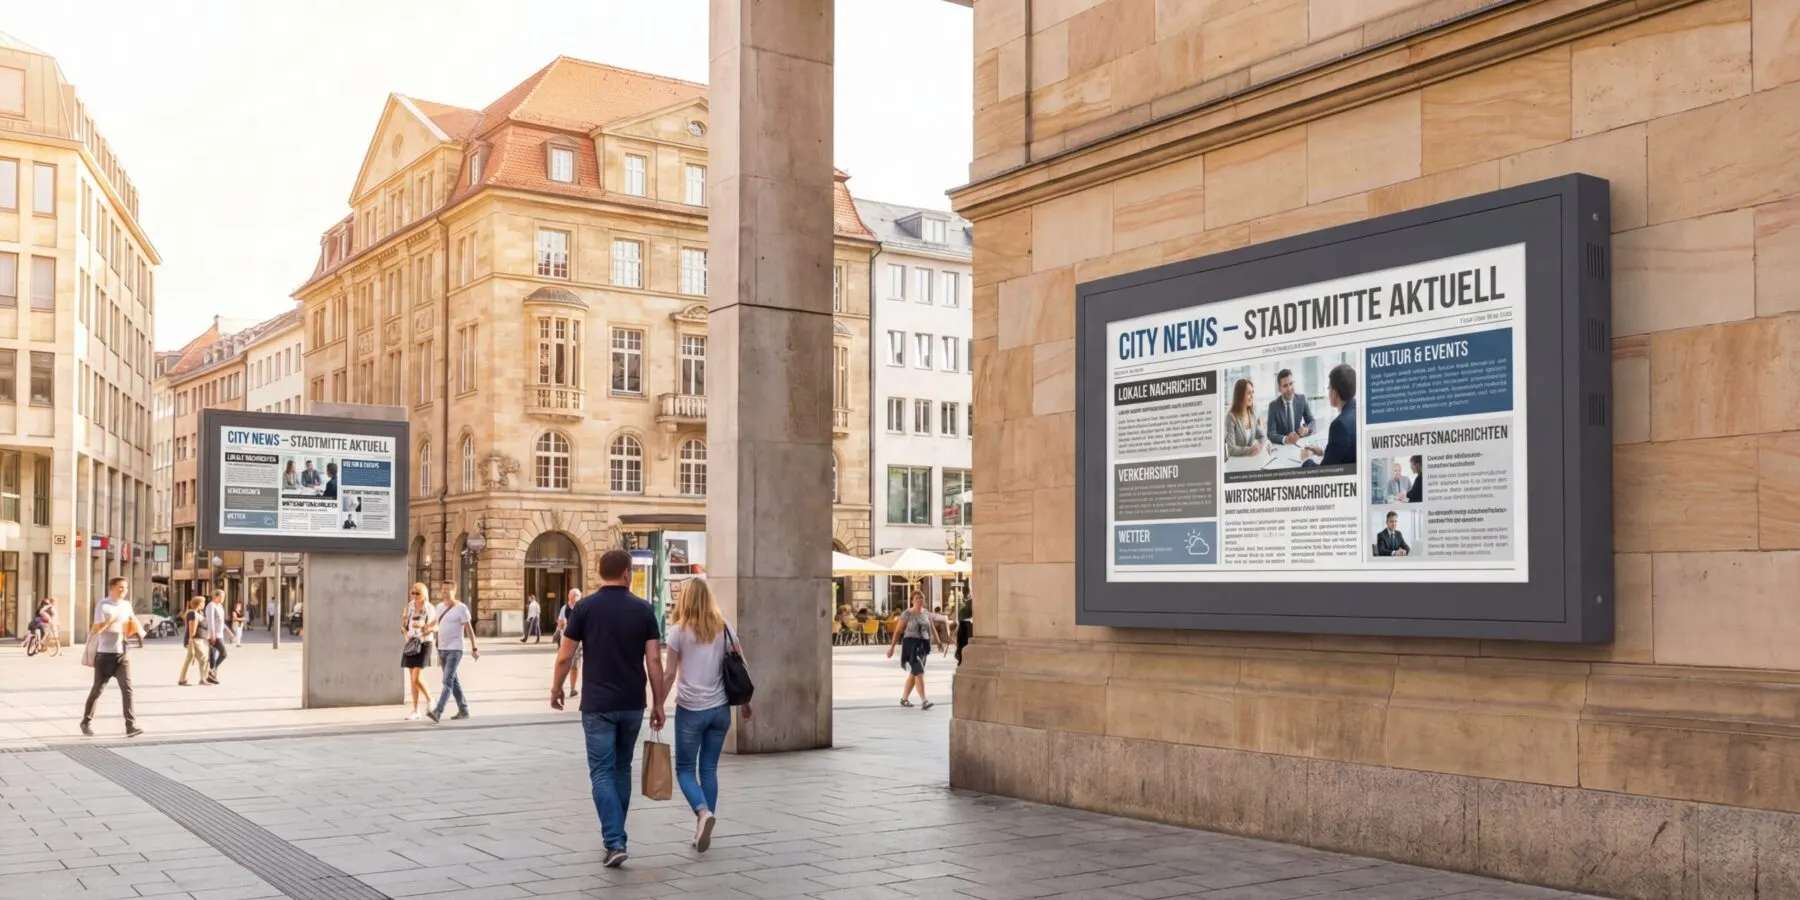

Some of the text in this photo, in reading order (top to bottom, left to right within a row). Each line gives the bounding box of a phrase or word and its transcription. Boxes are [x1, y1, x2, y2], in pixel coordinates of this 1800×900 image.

[1119, 327, 1158, 360] CITY
[1164, 316, 1218, 354] NEWS
[1244, 286, 1382, 340] STADTMITTE
[1389, 265, 1505, 317] AKTUELL
[1370, 340, 1469, 369] KULTUR & EVENTS
[1118, 376, 1207, 401] LOKALE NACHRICHTEN
[228, 430, 250, 444] CITY
[252, 432, 280, 446] NEWS
[290, 435, 348, 451] STADTMITTE
[349, 439, 389, 453] AKTUELL
[1371, 425, 1508, 449] WIRTSCHAFTSNACHRICHTEN
[1118, 464, 1179, 482] VERKEHRSINFO
[1224, 482, 1357, 504] WIRTSCHAFTSNACHRICHTEN
[1118, 529, 1151, 543] WETTER
